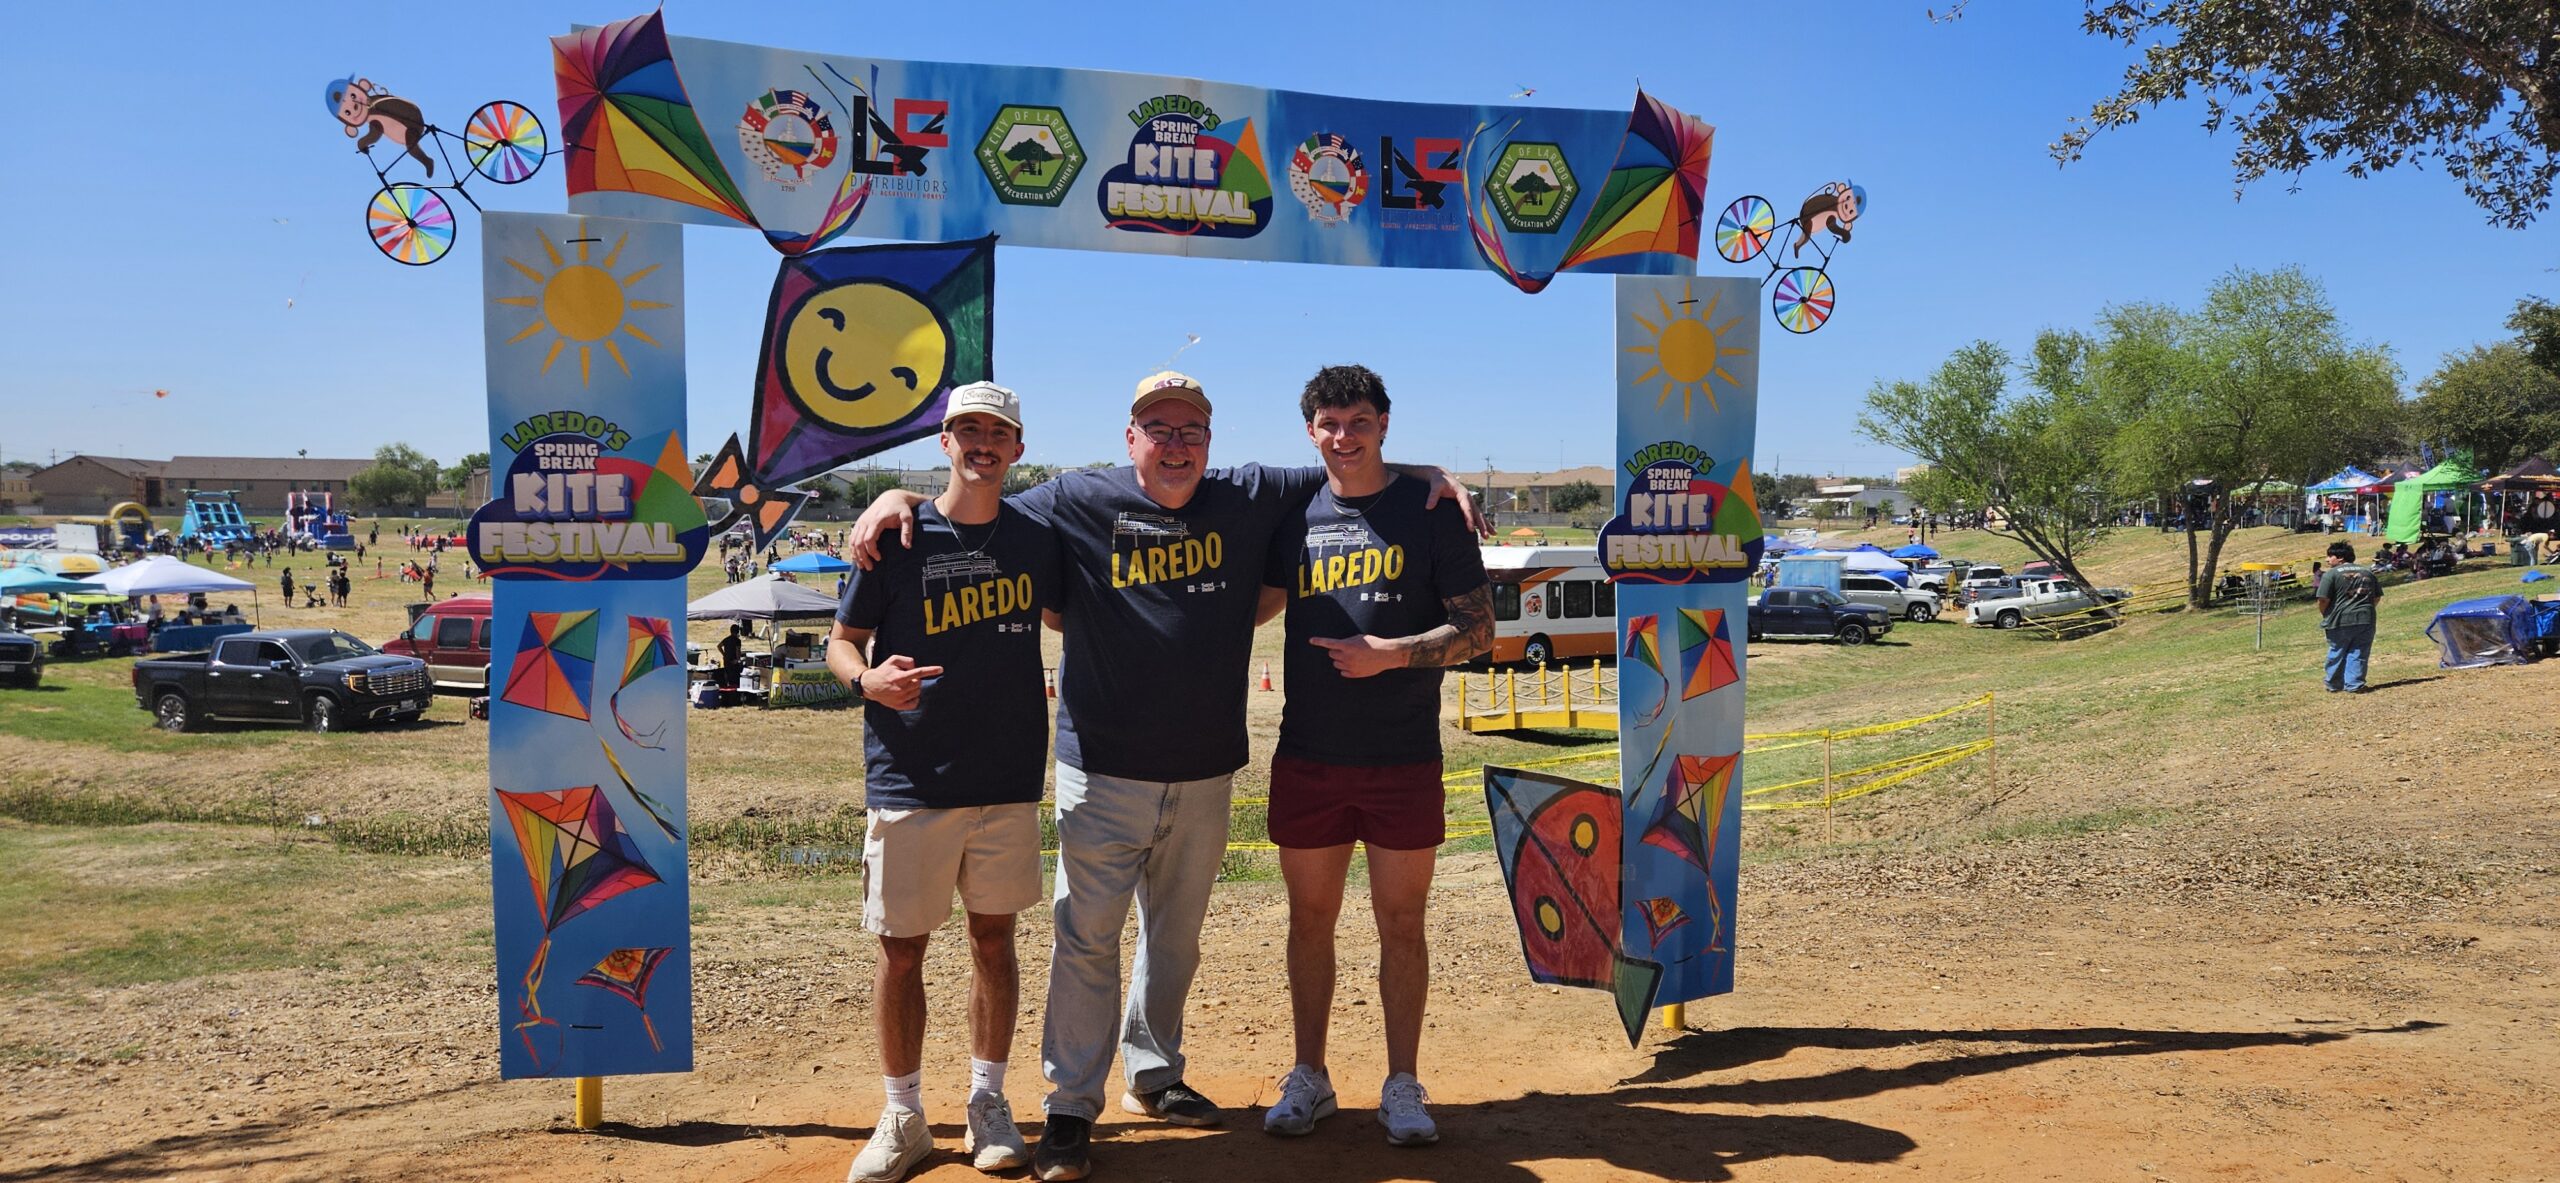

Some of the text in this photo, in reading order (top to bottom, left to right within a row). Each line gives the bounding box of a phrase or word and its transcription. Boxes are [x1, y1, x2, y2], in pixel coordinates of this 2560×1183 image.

[988, 111, 1074, 149] CITY OF LAREDO
[1128, 94, 1222, 131] LAREDO'S
[1152, 120, 1198, 134] SPRING
[1155, 131, 1196, 145] BREAK
[987, 159, 1003, 180] PARKS
[1003, 186, 1044, 200] RECREATION
[1045, 163, 1075, 200] DEPARTMENT
[1134, 143, 1219, 186] KITE
[1497, 147, 1569, 181] CITY OF LAREDO
[850, 174, 948, 193] DITRIBUTORS
[1107, 181, 1256, 225] FESTIVAL
[1496, 191, 1509, 211] PARKS
[1510, 215, 1544, 228] RECREATION
[1545, 193, 1570, 227] DEPARTMENT
[501, 411, 632, 454] LAREDO'S
[534, 443, 598, 457] SPRING
[539, 456, 596, 470] BREAK
[1624, 440, 1716, 478] LAREDO'S
[1647, 468, 1692, 480] SPRING
[512, 472, 633, 520] KITE
[1650, 480, 1689, 490] BREAK
[1630, 492, 1713, 533] KITE
[479, 521, 687, 563] FESTIVAL
[1111, 531, 1222, 589] LAREDO
[1606, 534, 1748, 570] FESTIVAL
[1299, 544, 1405, 599] LAREDO
[923, 572, 1033, 636] LAREDO
